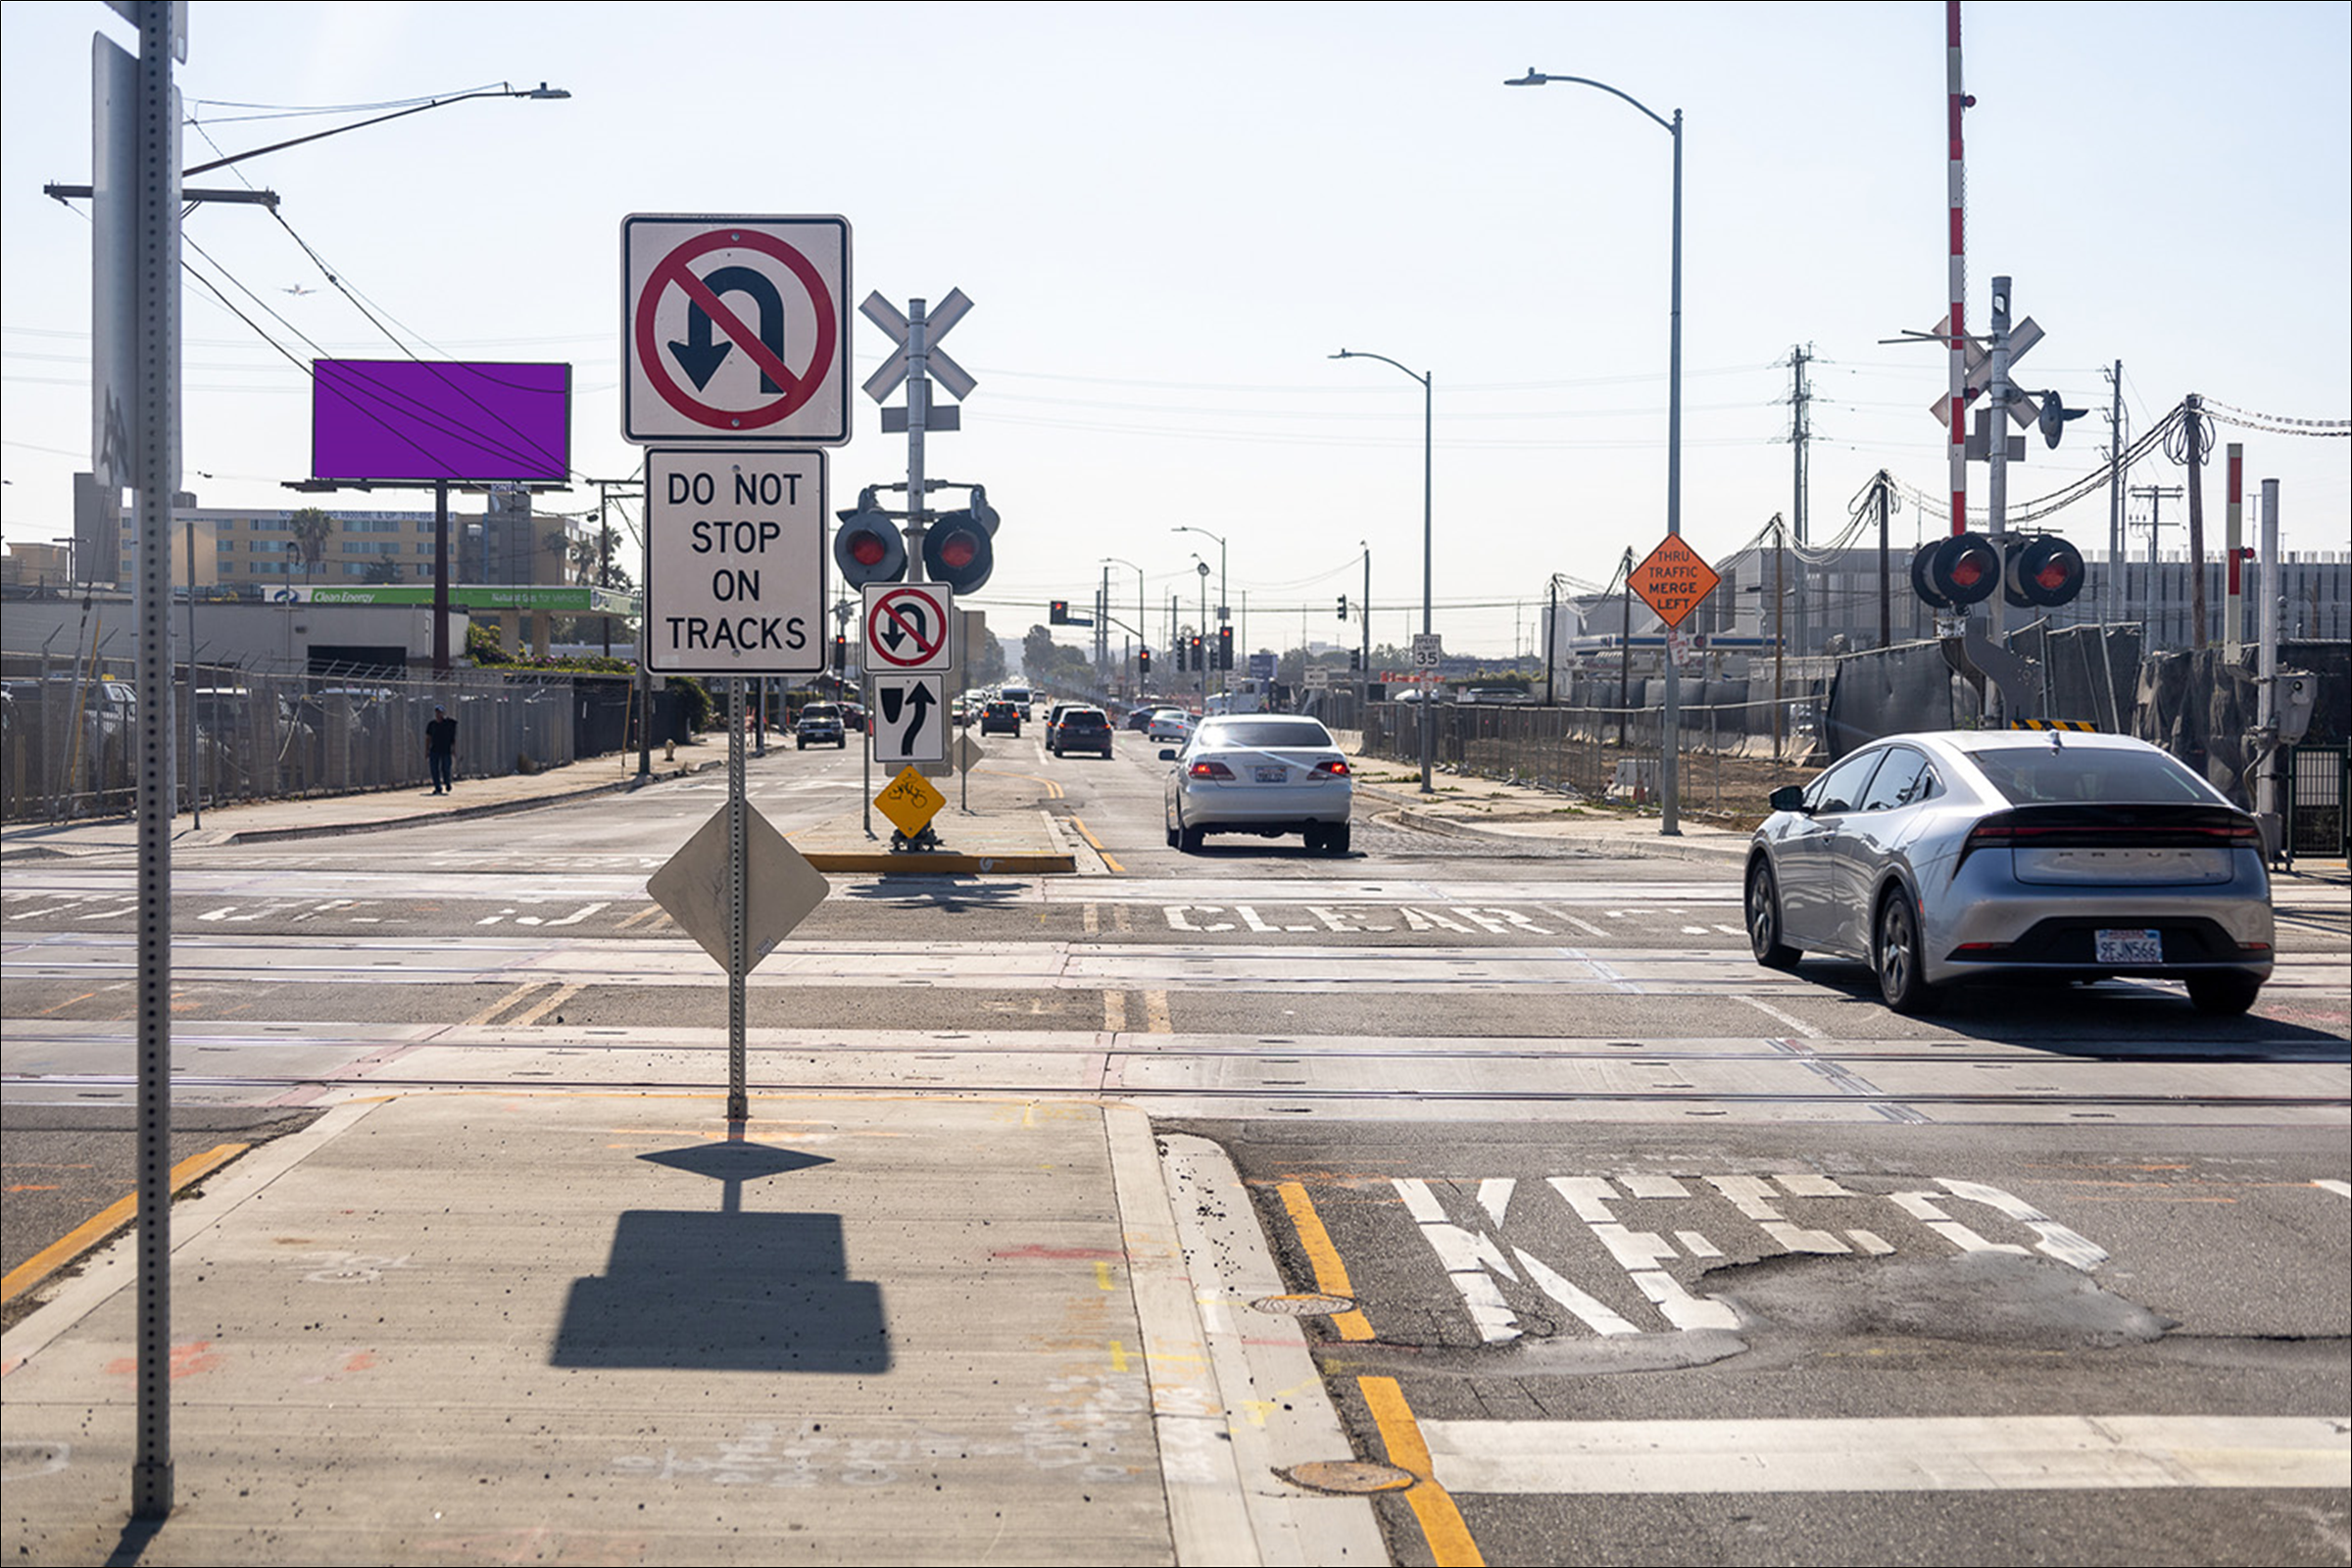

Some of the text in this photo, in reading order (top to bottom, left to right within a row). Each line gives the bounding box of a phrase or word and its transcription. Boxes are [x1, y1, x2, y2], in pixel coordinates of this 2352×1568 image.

[668, 472, 802, 505] DO NOT
[691, 521, 781, 554] STOP
[1657, 550, 1690, 562] THRU
[1648, 566, 1697, 578] TRAFFIC
[712, 569, 760, 602] ON
[1648, 582, 1697, 594] MERGE
[314, 591, 375, 604] Clean Energy
[1657, 598, 1690, 610] LEFT
[665, 617, 807, 650] TRACKS
[1416, 651, 1438, 665] 35
[1162, 905, 1556, 936] CLEAR
